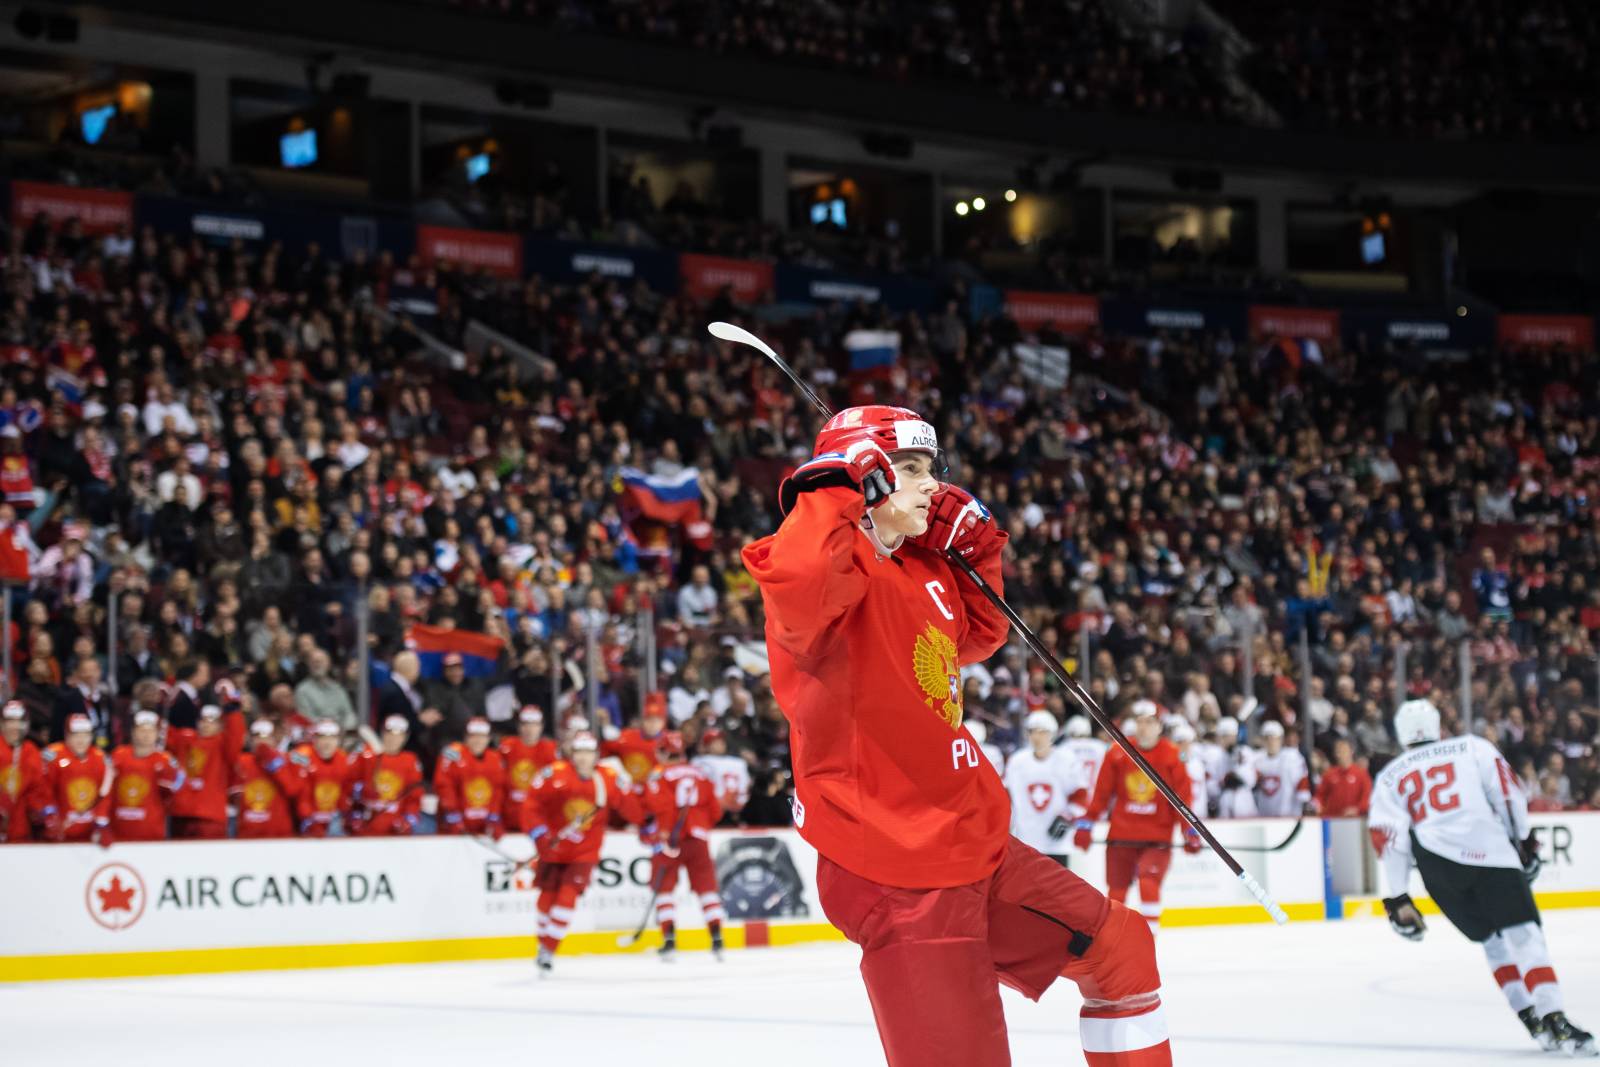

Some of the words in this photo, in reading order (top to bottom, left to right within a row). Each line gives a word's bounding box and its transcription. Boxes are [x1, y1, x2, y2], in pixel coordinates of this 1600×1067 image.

[925, 580, 954, 620] C
[1398, 762, 1460, 824] 22
[157, 877, 222, 909] AIR
[231, 872, 396, 908] CANADA
